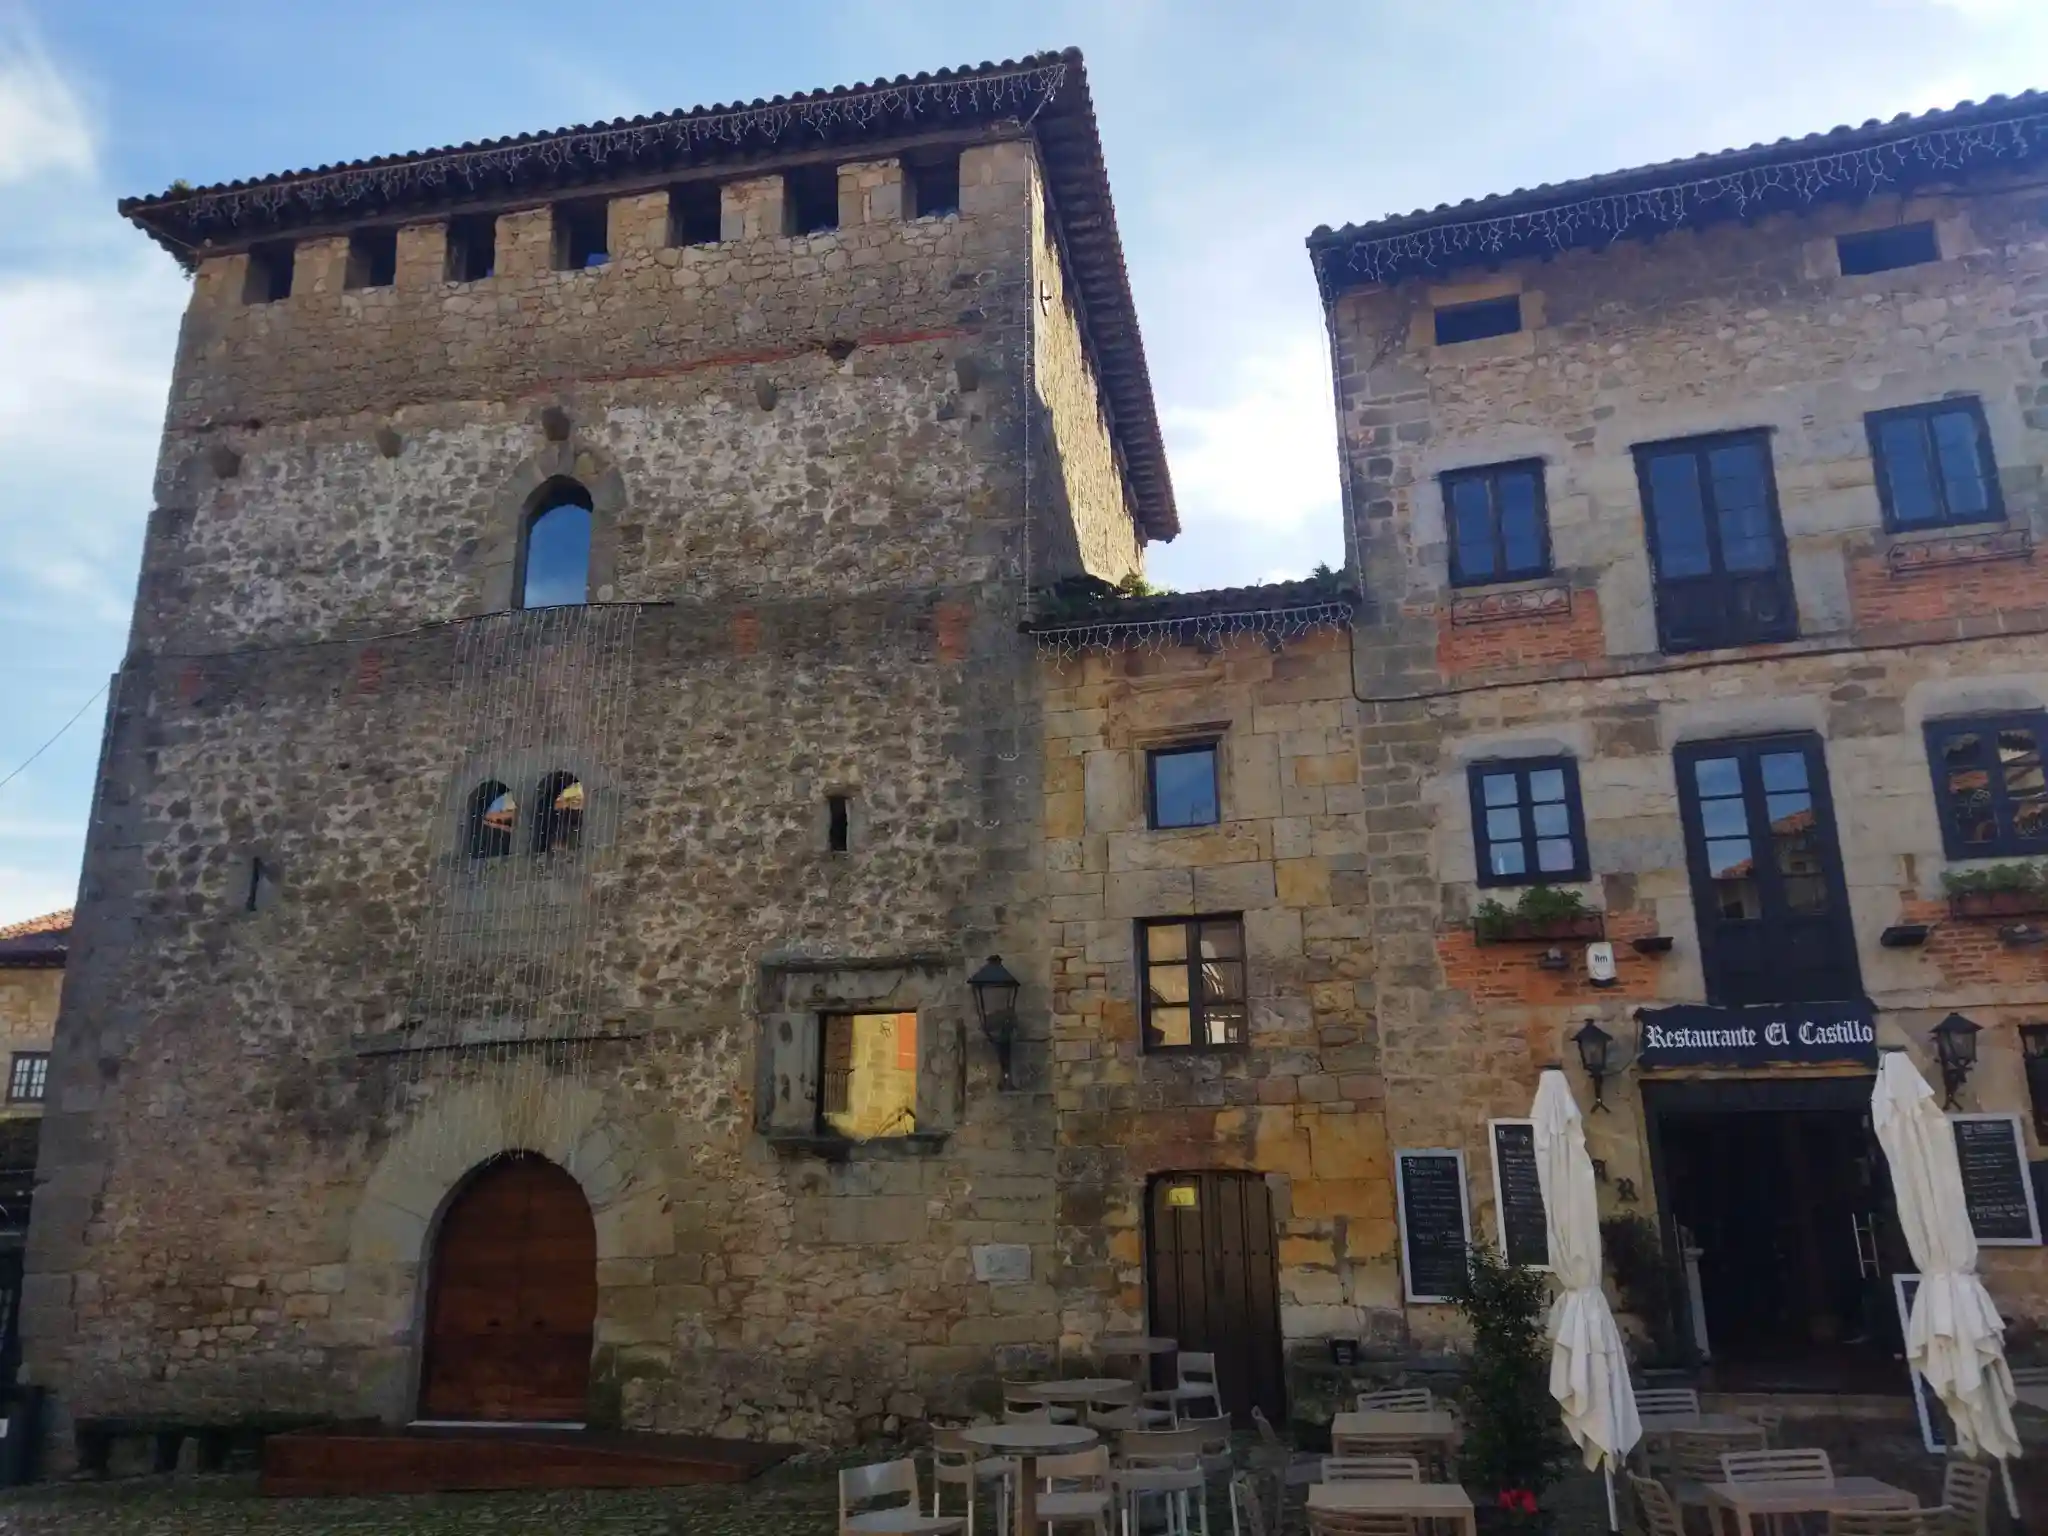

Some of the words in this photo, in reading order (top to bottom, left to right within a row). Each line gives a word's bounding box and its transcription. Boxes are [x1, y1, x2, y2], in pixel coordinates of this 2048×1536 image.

[1646, 1024, 1758, 1048] Restaurante
[1764, 1021, 1790, 1046] El
[1798, 1019, 1874, 1046] Castillo
